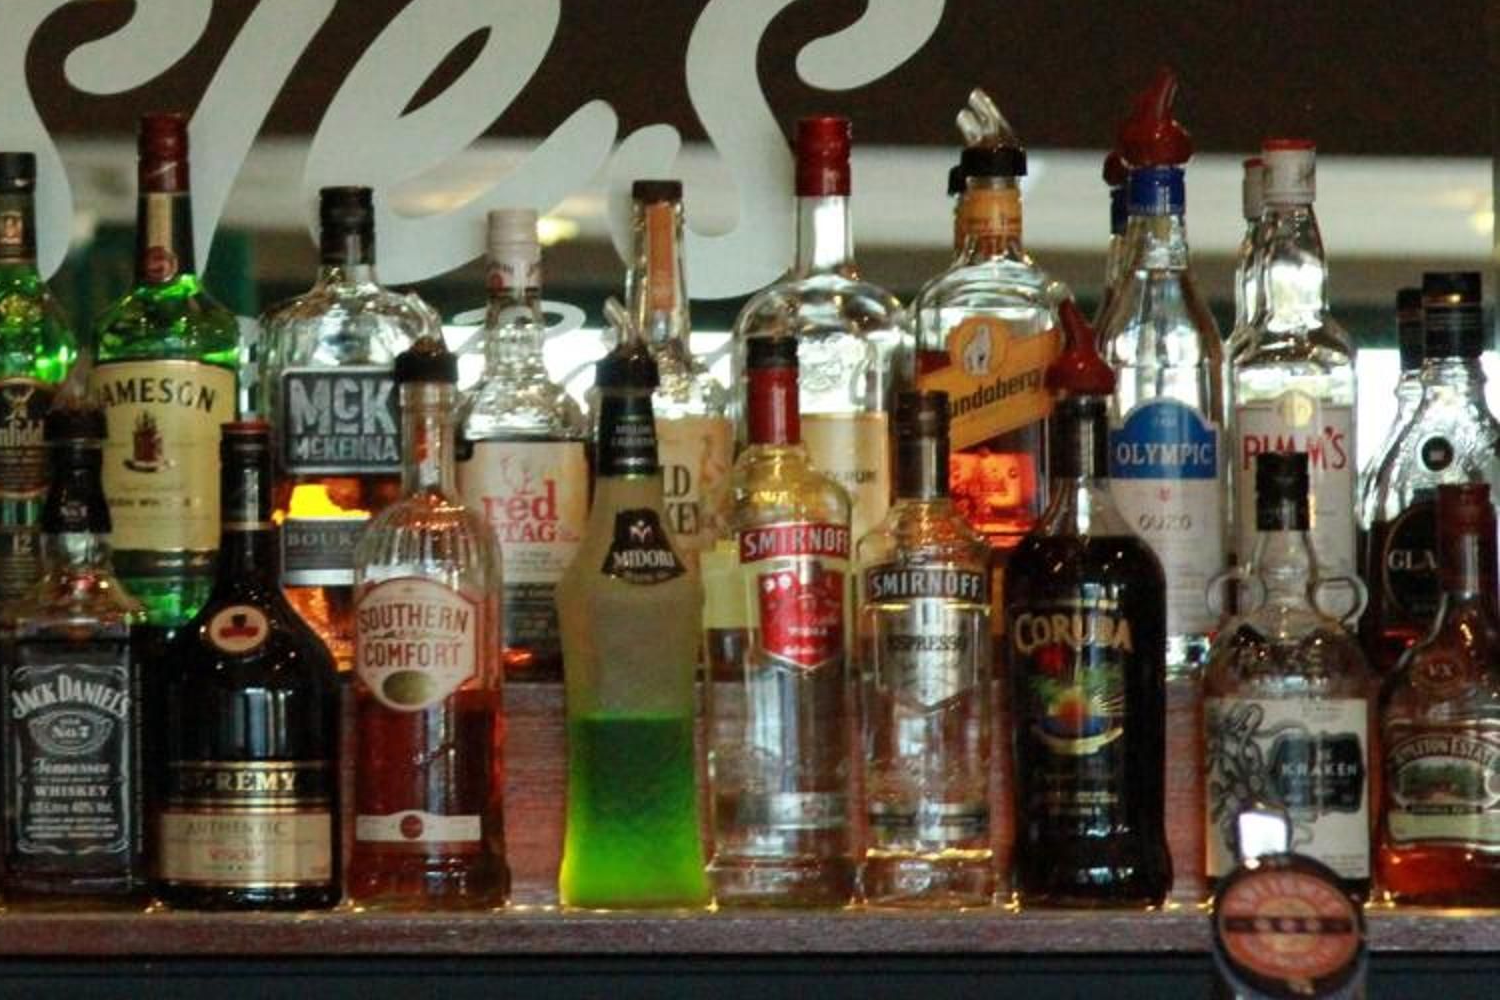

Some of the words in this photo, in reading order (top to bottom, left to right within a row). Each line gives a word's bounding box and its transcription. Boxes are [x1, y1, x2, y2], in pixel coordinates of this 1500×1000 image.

[1116, 442, 1213, 466] OLYMPIC
[482, 478, 559, 523] red
[287, 533, 354, 548] BOUR
[612, 552, 676, 569] MIDORI
[1387, 550, 1437, 570] GLA
[872, 571, 981, 599] SMIRNOFF
[360, 603, 469, 634] SOUTHERN
[1014, 613, 1133, 656] CORUBA
[363, 641, 463, 668] COMFORT
[11, 681, 57, 720] JACK
[56, 673, 132, 719] DANIEL'S
[1281, 763, 1358, 777] KRAKEN
[33, 784, 111, 798] WHISKEY
[186, 820, 289, 836] AUTHENTIC
